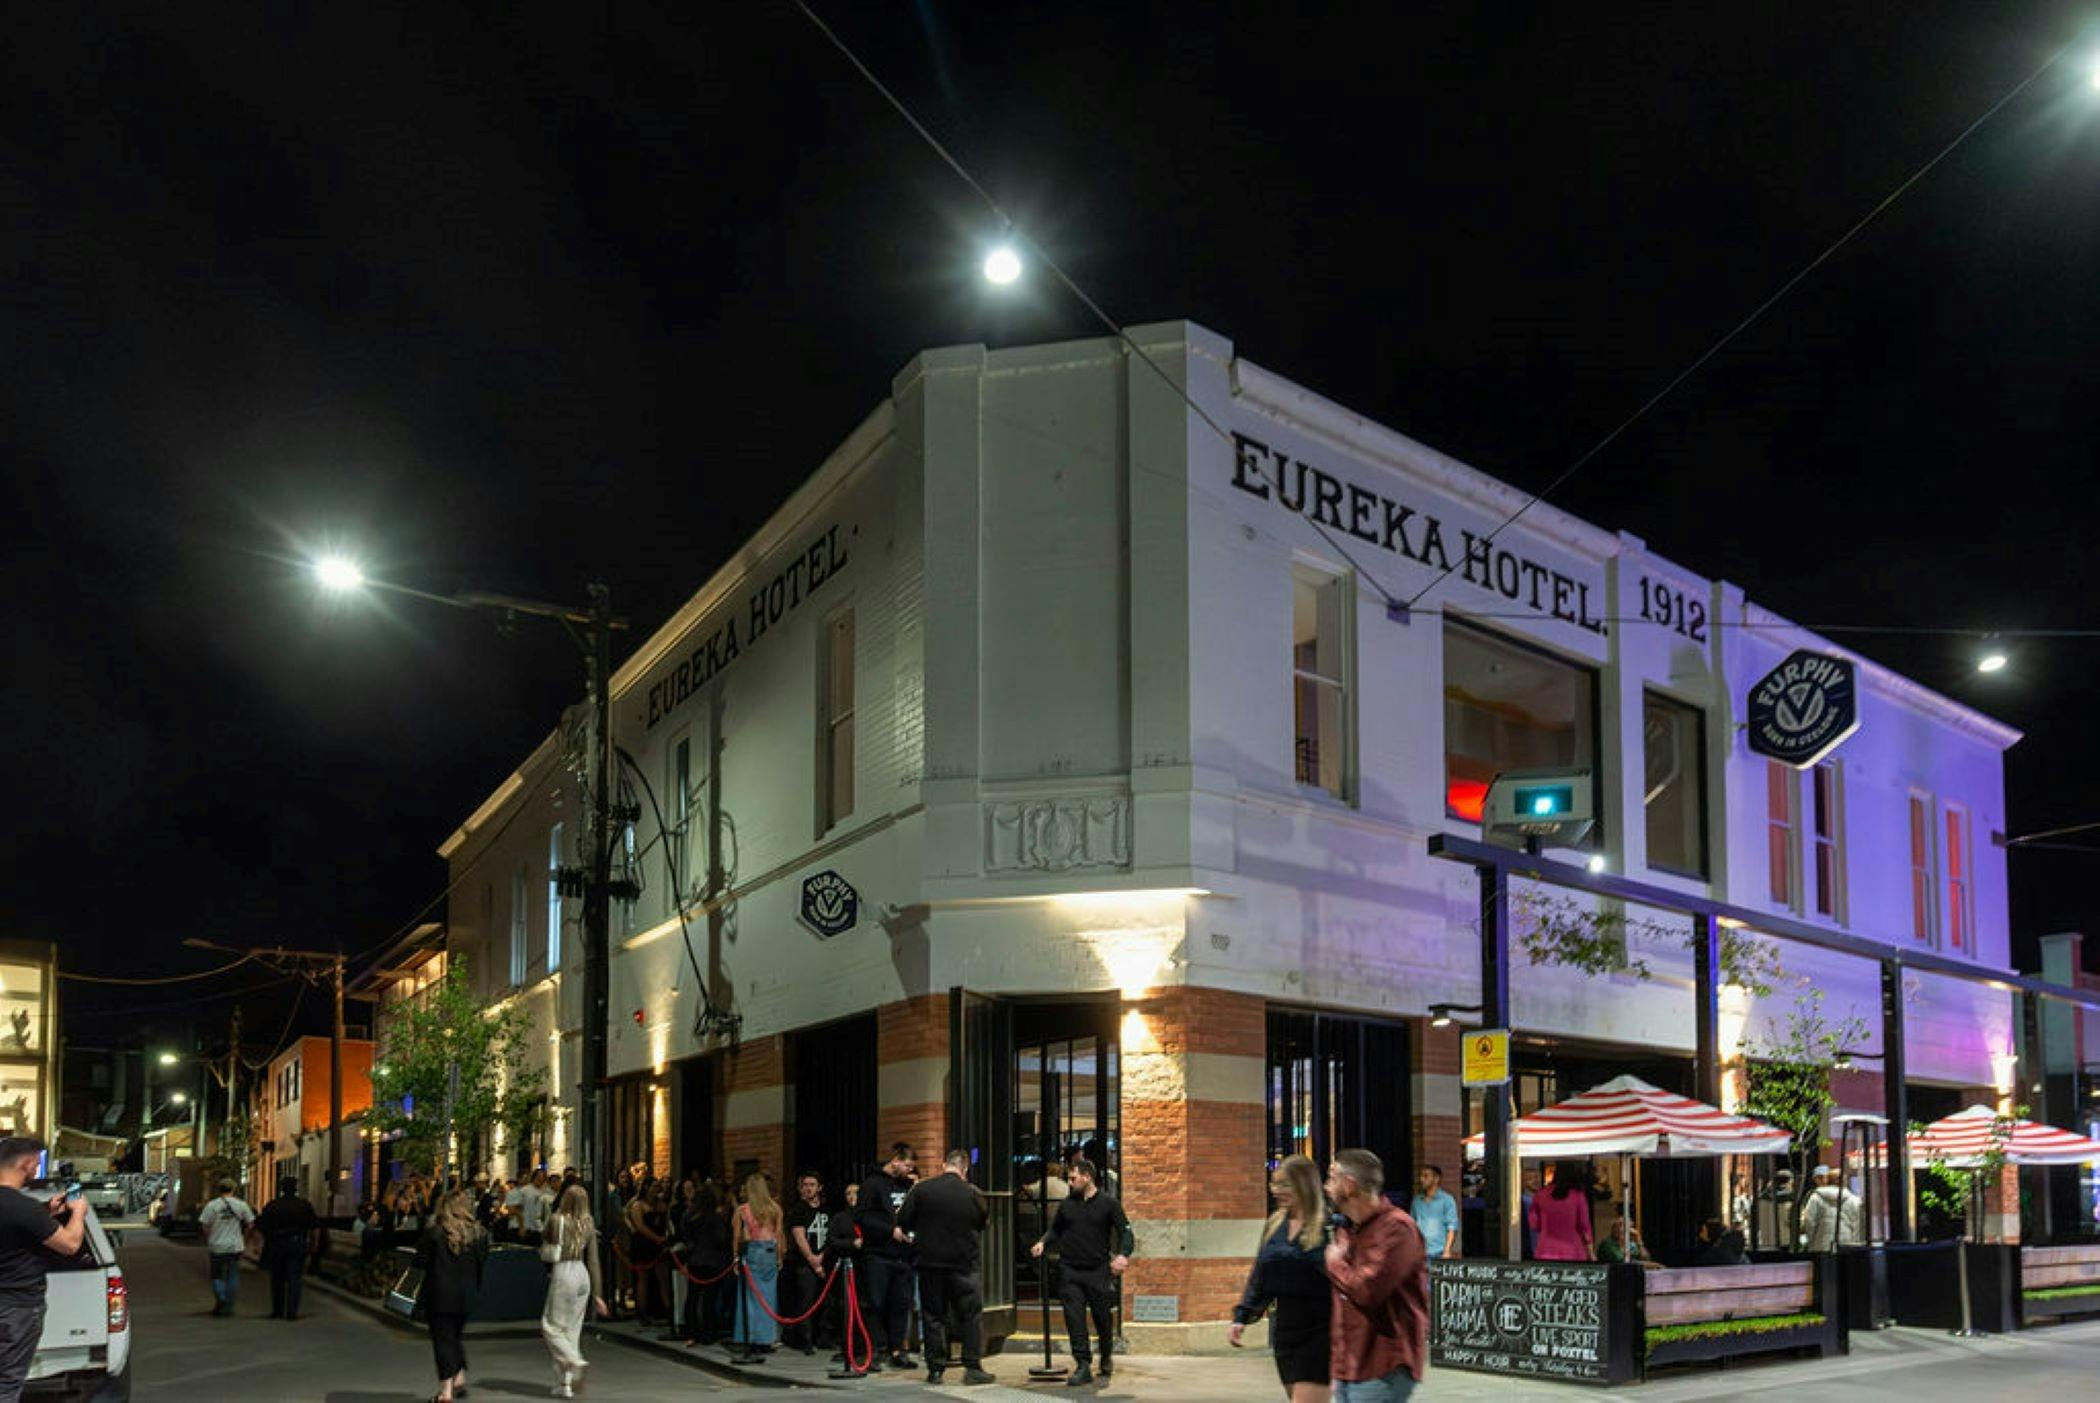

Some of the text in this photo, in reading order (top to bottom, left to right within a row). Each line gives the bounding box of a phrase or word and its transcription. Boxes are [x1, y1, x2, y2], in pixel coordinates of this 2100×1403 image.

[1230, 430, 1452, 572] EUREKA
[1640, 576, 1707, 643] 1912
[646, 617, 742, 728] EUREKA
[1756, 657, 1845, 706] FURPHY
[806, 874, 854, 901] FURPHY
[1442, 1264, 1465, 1278] LIVE
[1440, 1281, 1481, 1310] PARMI
[1530, 1286, 1598, 1305] DRY AGED
[1440, 1304, 1488, 1331] PARMA
[1531, 1302, 1600, 1326] STEAKS
[1532, 1326, 1598, 1349] LIVE SPORT
[1443, 1349, 1478, 1365] HAPPY
[1483, 1353, 1510, 1369] HOUR
[1532, 1344, 1599, 1362] ON FOXTEL
